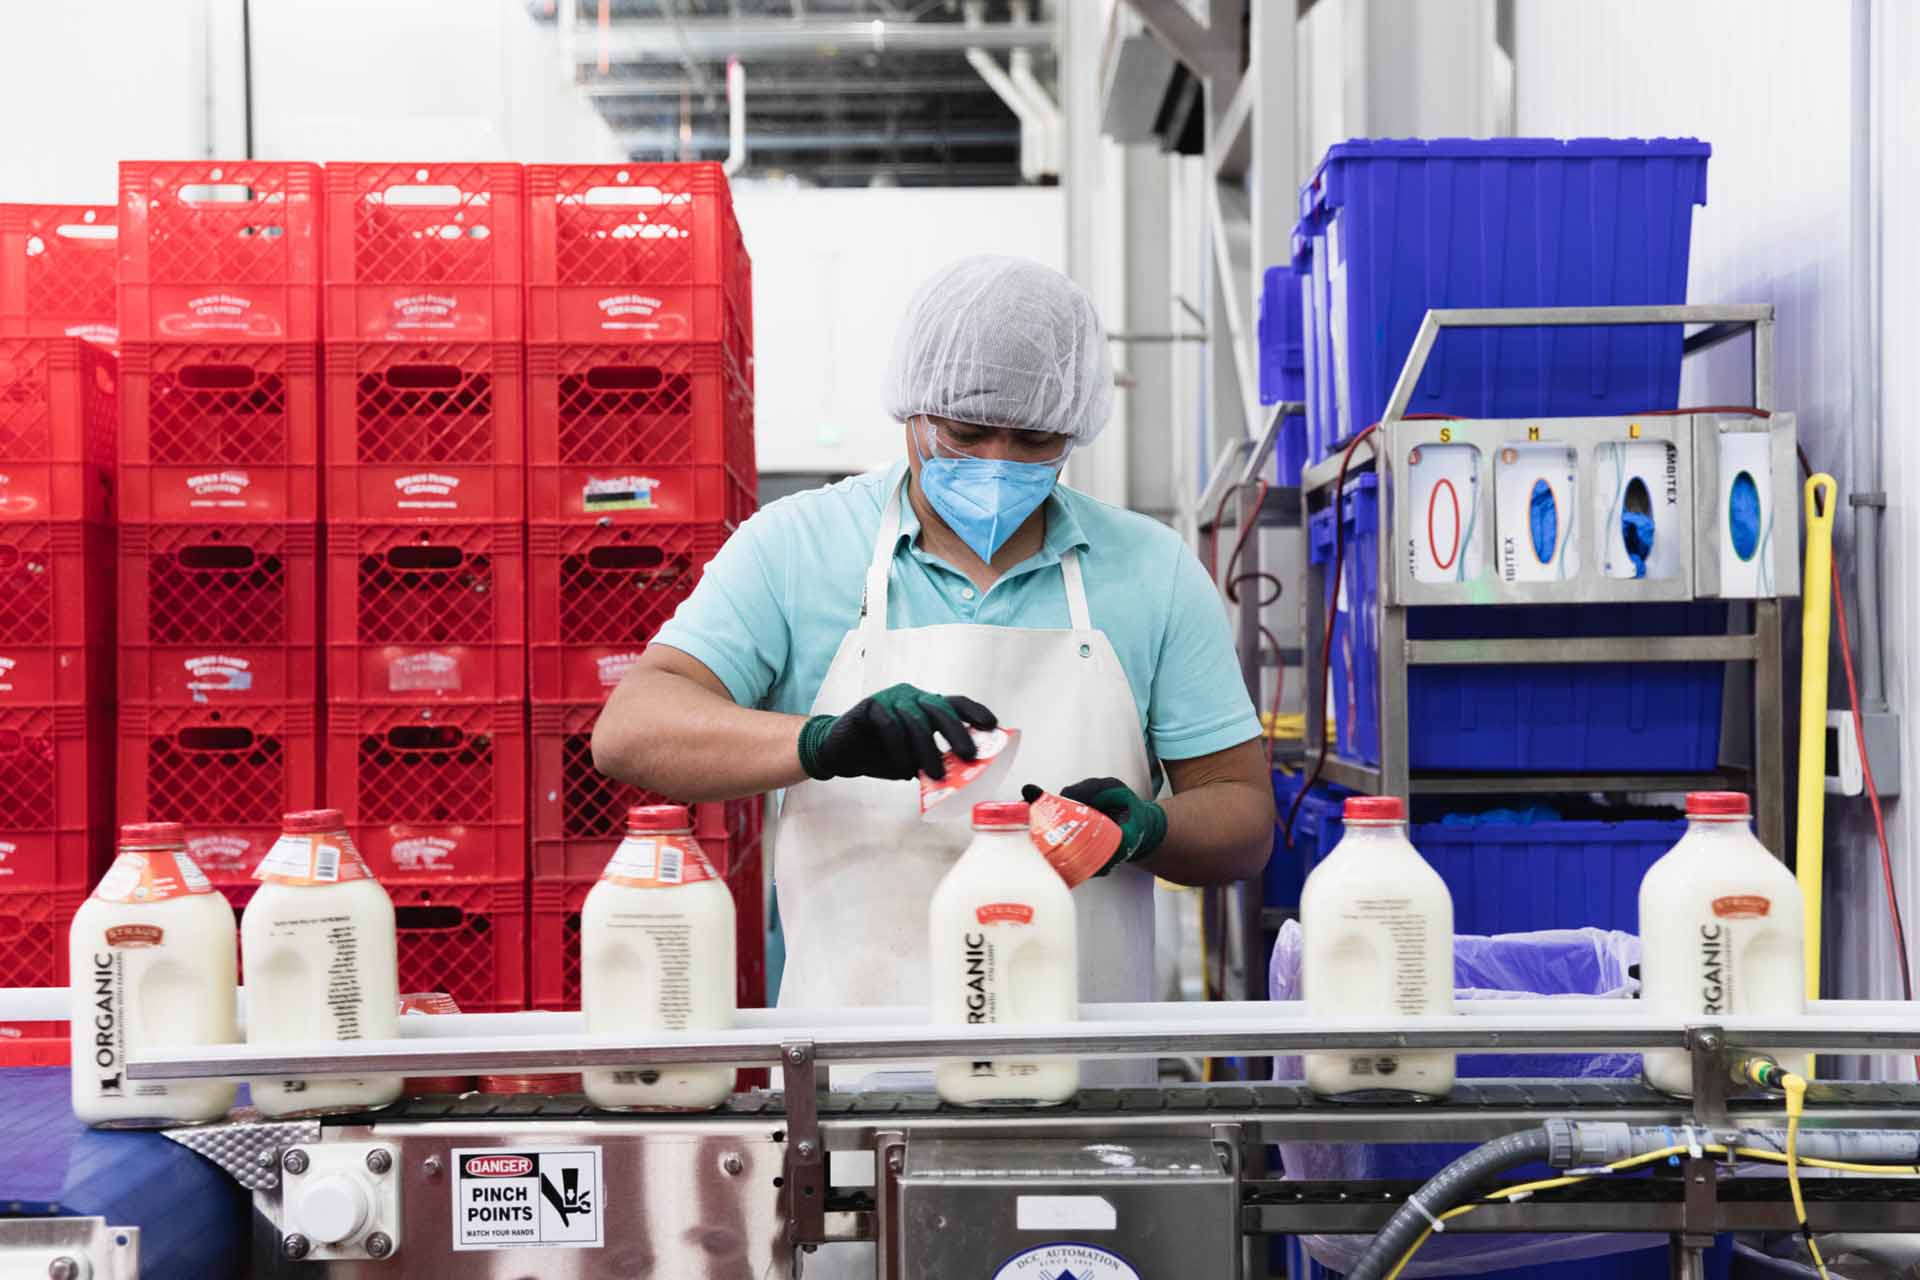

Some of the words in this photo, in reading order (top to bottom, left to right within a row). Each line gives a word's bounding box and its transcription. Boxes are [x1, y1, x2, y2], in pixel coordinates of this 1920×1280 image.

[1440, 428, 1451, 443] S
[1528, 426, 1540, 441] M
[1630, 423, 1640, 439] L
[1701, 924, 1724, 1016] RGANIC
[965, 933, 986, 1024] RGANIC
[94, 952, 115, 1068] ORGANIC
[471, 1159, 529, 1173] DANGER
[472, 1187, 527, 1202] PINCH
[468, 1207, 533, 1222] POINTS
[467, 1229, 490, 1237] WATCH
[492, 1229, 510, 1237] YOUR
[512, 1228, 534, 1237] HANDS
[1046, 1248, 1120, 1271] AUTOMATION
